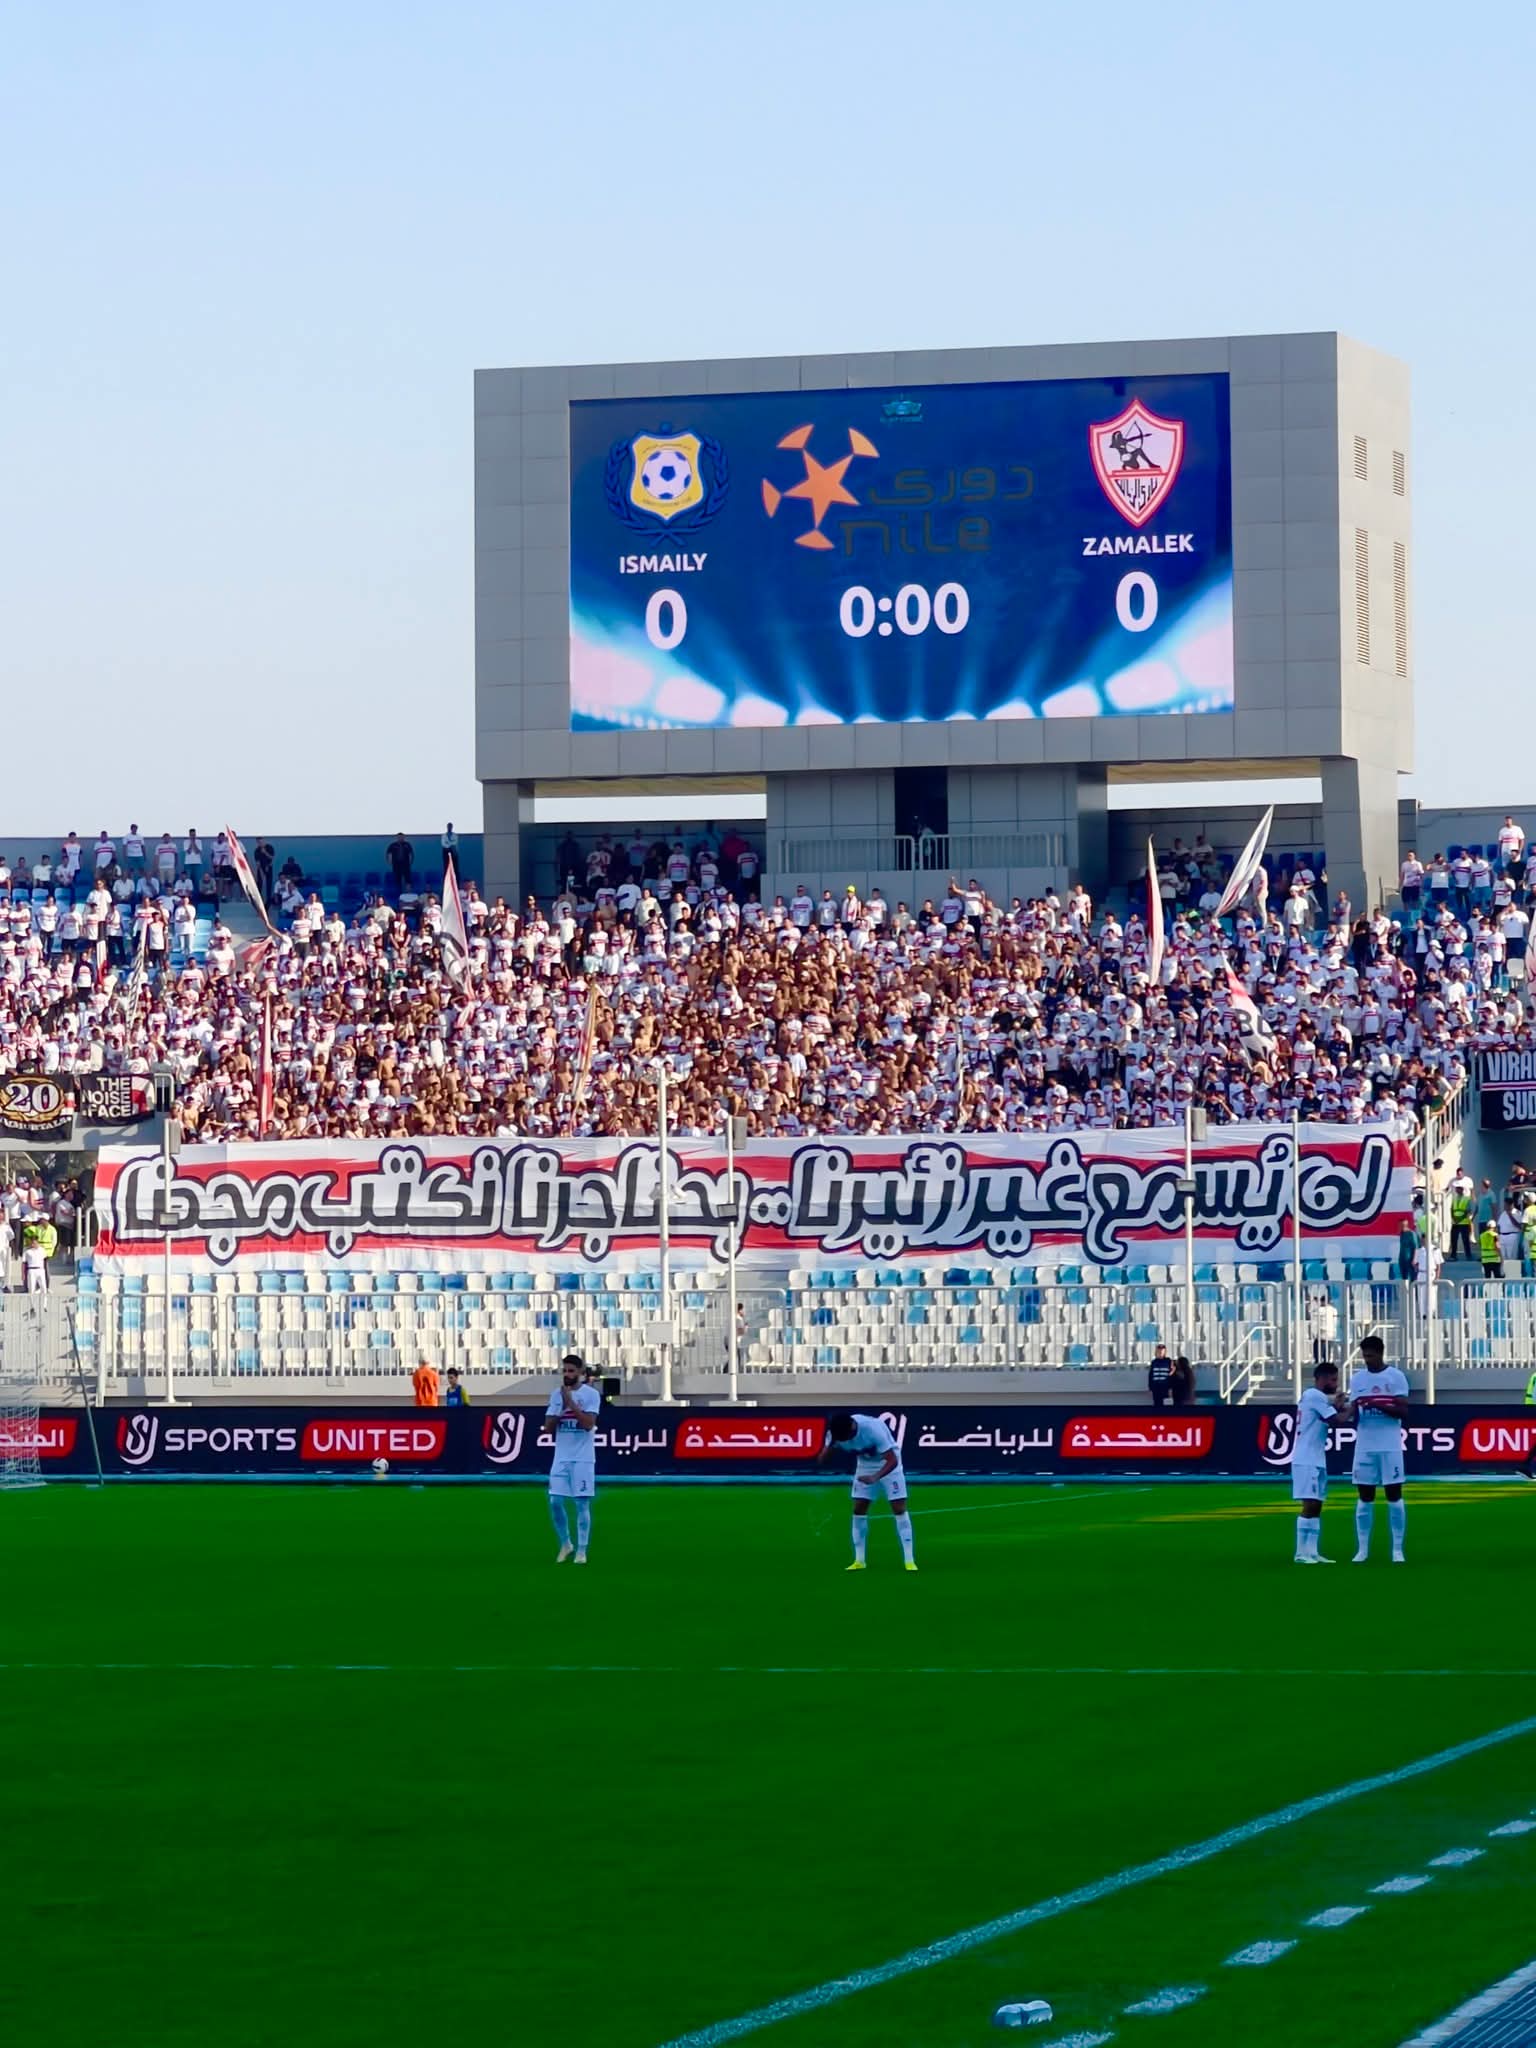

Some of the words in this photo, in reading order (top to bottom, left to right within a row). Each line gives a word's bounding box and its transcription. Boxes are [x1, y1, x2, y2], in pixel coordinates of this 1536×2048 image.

[1082, 534, 1195, 556] ZAMALEK
[619, 553, 708, 574] ISMAILY
[839, 582, 970, 638] 0:00
[1115, 571, 1159, 633] 0
[645, 588, 688, 651] 0
[1486, 1050, 1536, 1081] VIRA
[96, 1076, 130, 1091] THE
[5, 1083, 60, 1113] 20
[82, 1090, 131, 1105] NOISE
[165, 1429, 297, 1451] SPORTS
[313, 1429, 436, 1451] UNITED
[685, 1426, 812, 1447] المتحدة
[918, 1425, 1053, 1455] للرياضة
[1072, 1425, 1201, 1447] المتحدة
